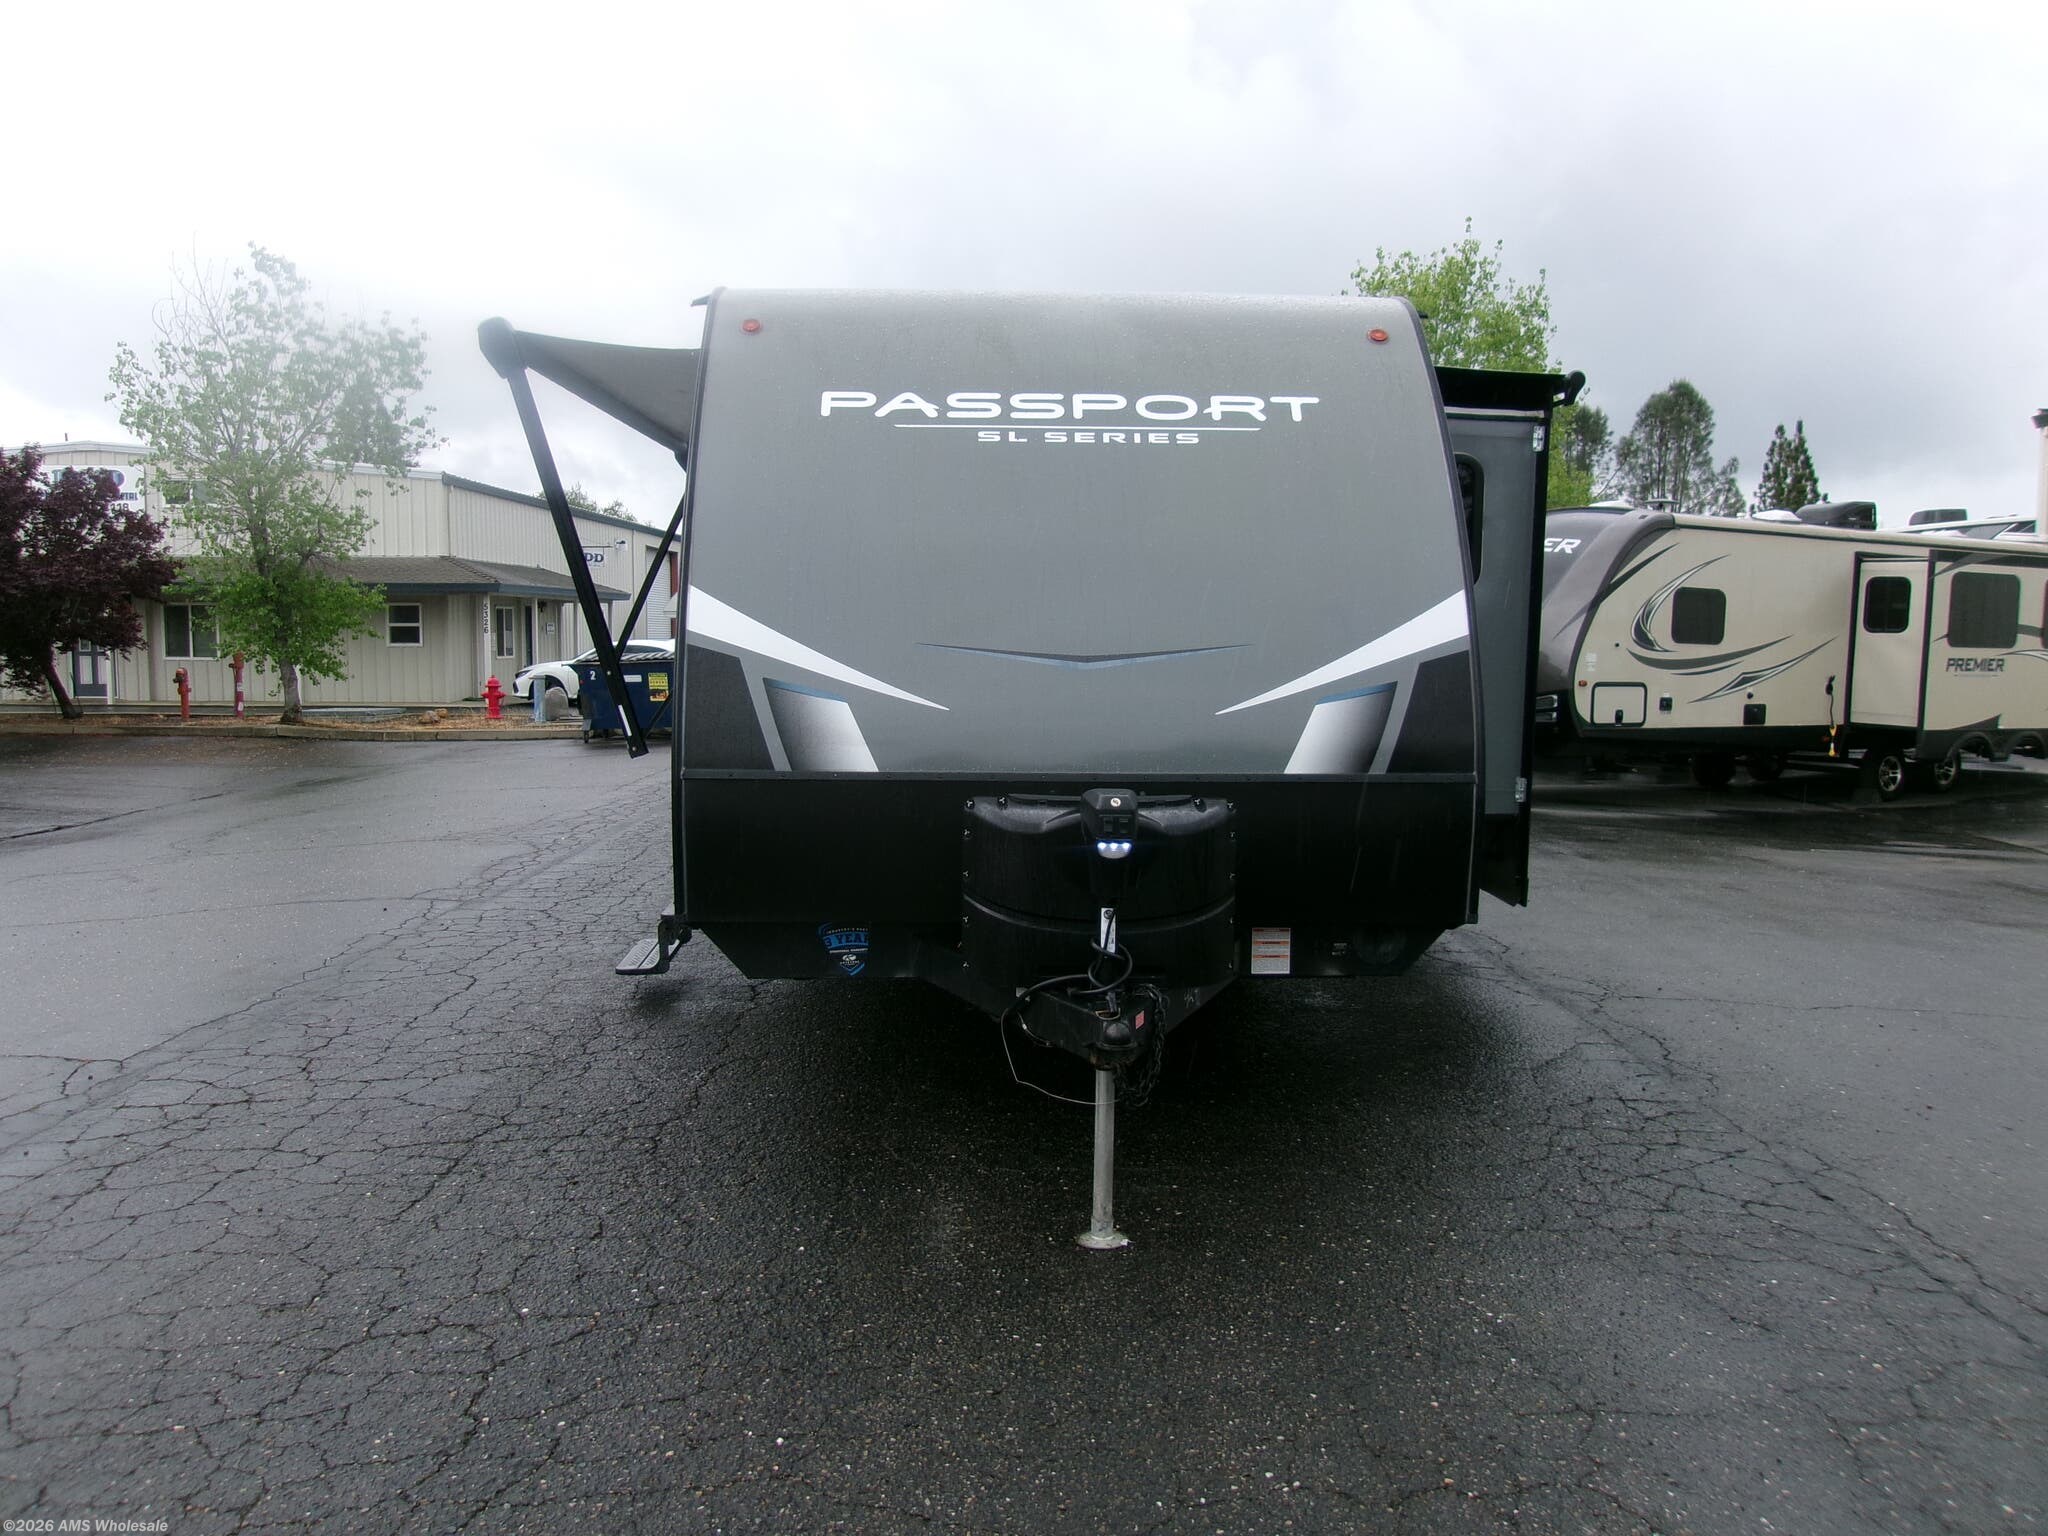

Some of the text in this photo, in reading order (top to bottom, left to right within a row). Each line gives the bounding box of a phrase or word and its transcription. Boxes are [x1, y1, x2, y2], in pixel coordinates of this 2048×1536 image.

[820, 391, 1320, 422] PASSPORT
[977, 431, 1200, 444] SL SERIES
[1543, 537, 1582, 554] ER
[1945, 657, 2005, 672] PREMIER
[589, 670, 597, 681] 2
